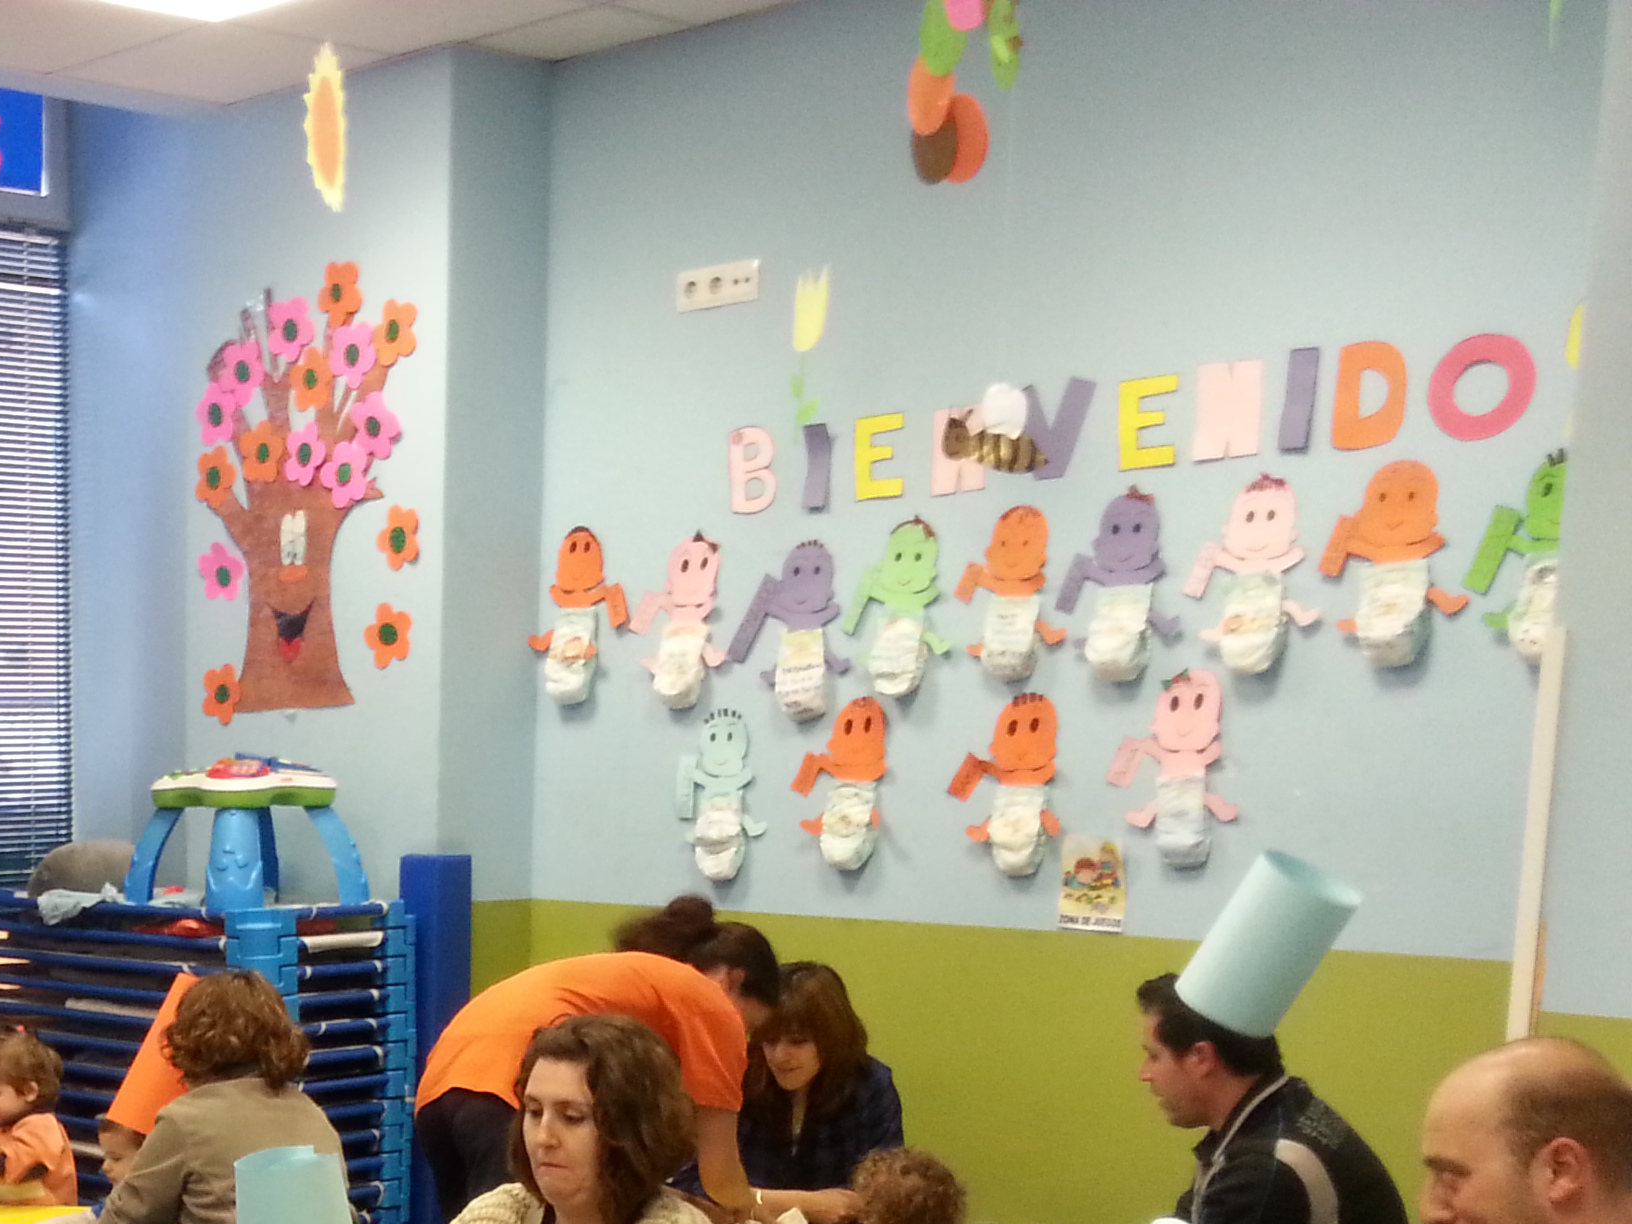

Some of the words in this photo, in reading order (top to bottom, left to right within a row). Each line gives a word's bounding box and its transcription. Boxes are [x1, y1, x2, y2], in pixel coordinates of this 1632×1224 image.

[1058, 914, 1079, 925] ZONA
[1081, 916, 1091, 926] DE
[1092, 917, 1122, 928] JUEGOS
